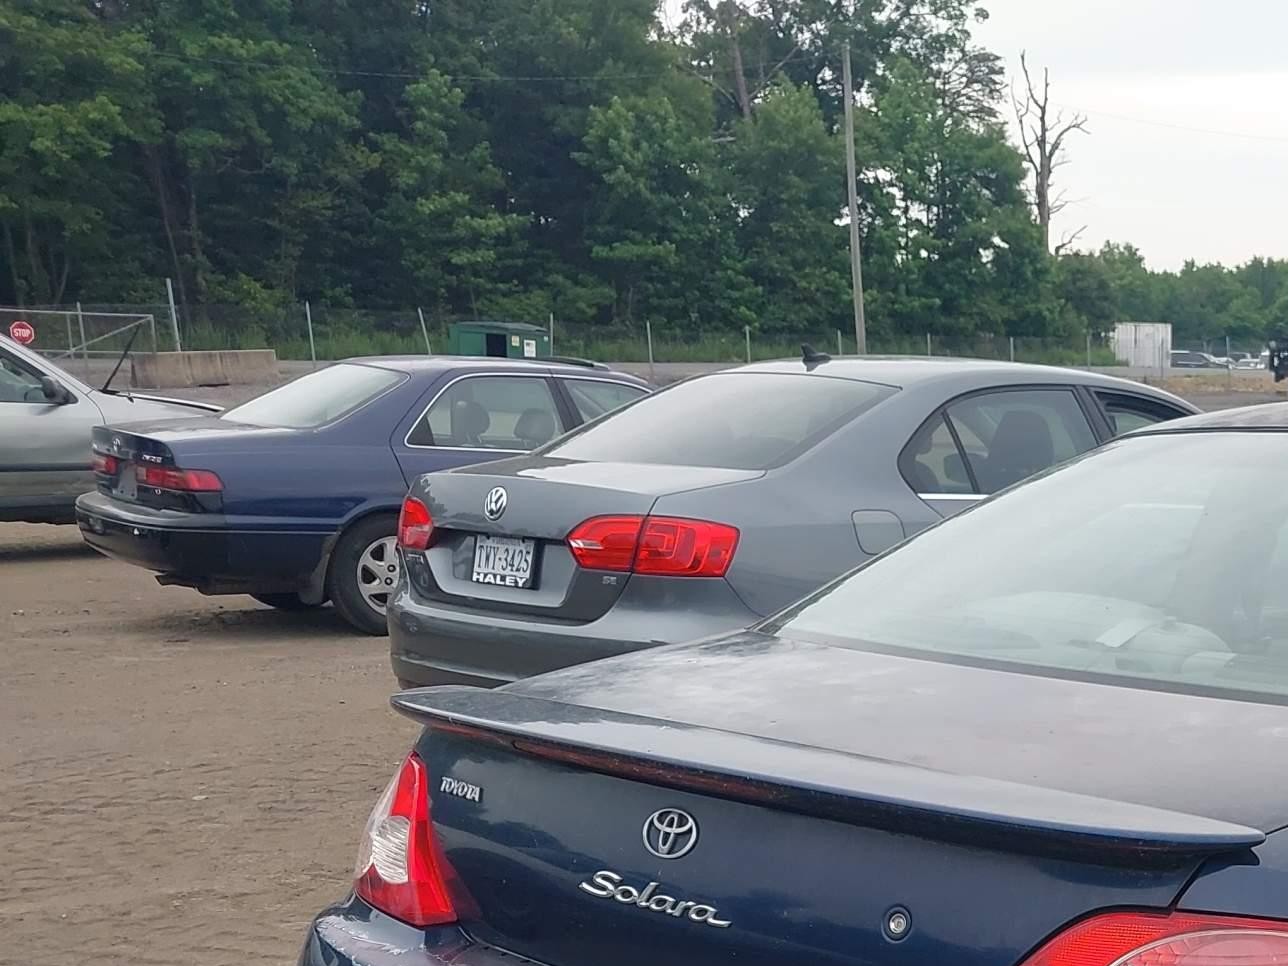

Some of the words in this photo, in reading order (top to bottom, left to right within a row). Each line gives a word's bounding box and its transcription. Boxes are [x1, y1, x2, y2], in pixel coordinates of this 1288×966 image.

[13, 328, 31, 337] STOP
[472, 572, 527, 588] HALEY
[440, 776, 481, 802] TOYOTA
[578, 870, 733, 928] Solara
